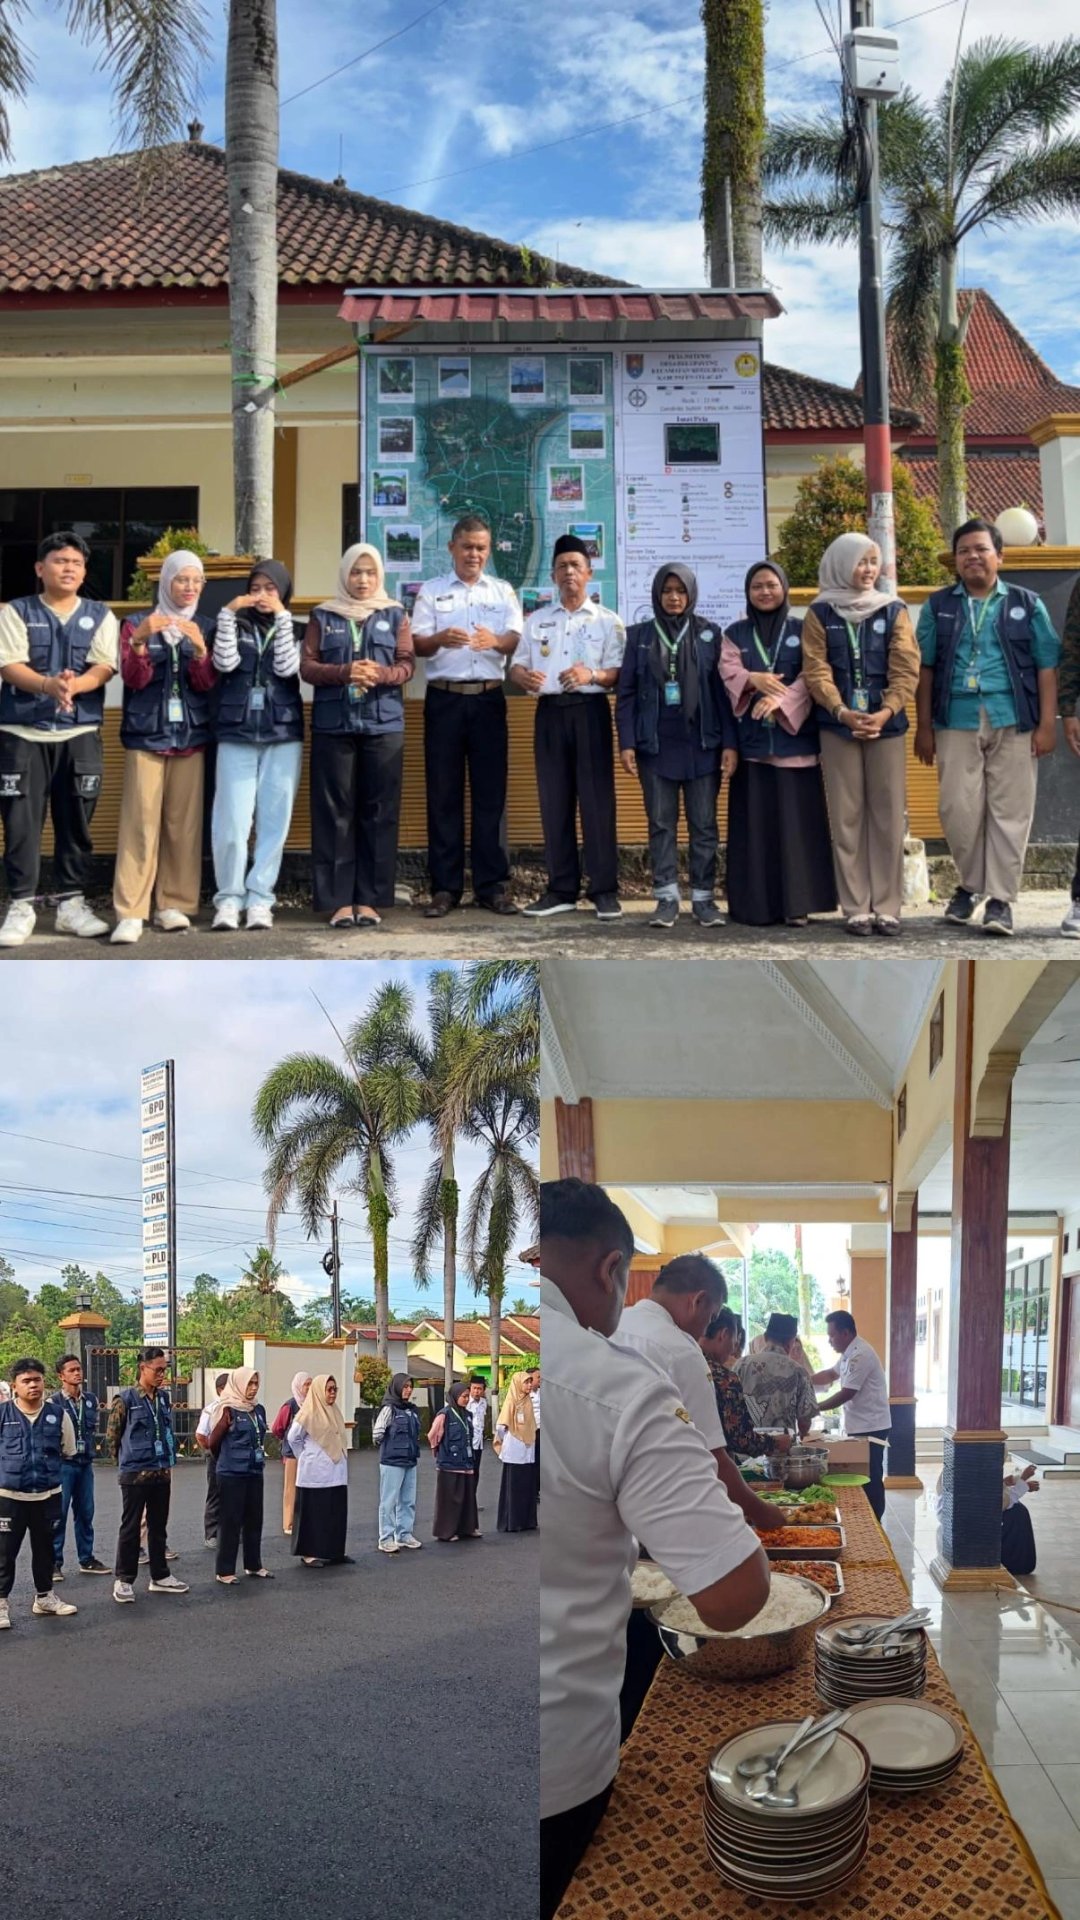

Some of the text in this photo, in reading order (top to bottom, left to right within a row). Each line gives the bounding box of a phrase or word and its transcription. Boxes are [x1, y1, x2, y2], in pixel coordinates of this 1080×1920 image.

[149, 1099, 164, 1114] BPD
[151, 1190, 165, 1205] PKK
[152, 1251, 166, 1264] PLD
